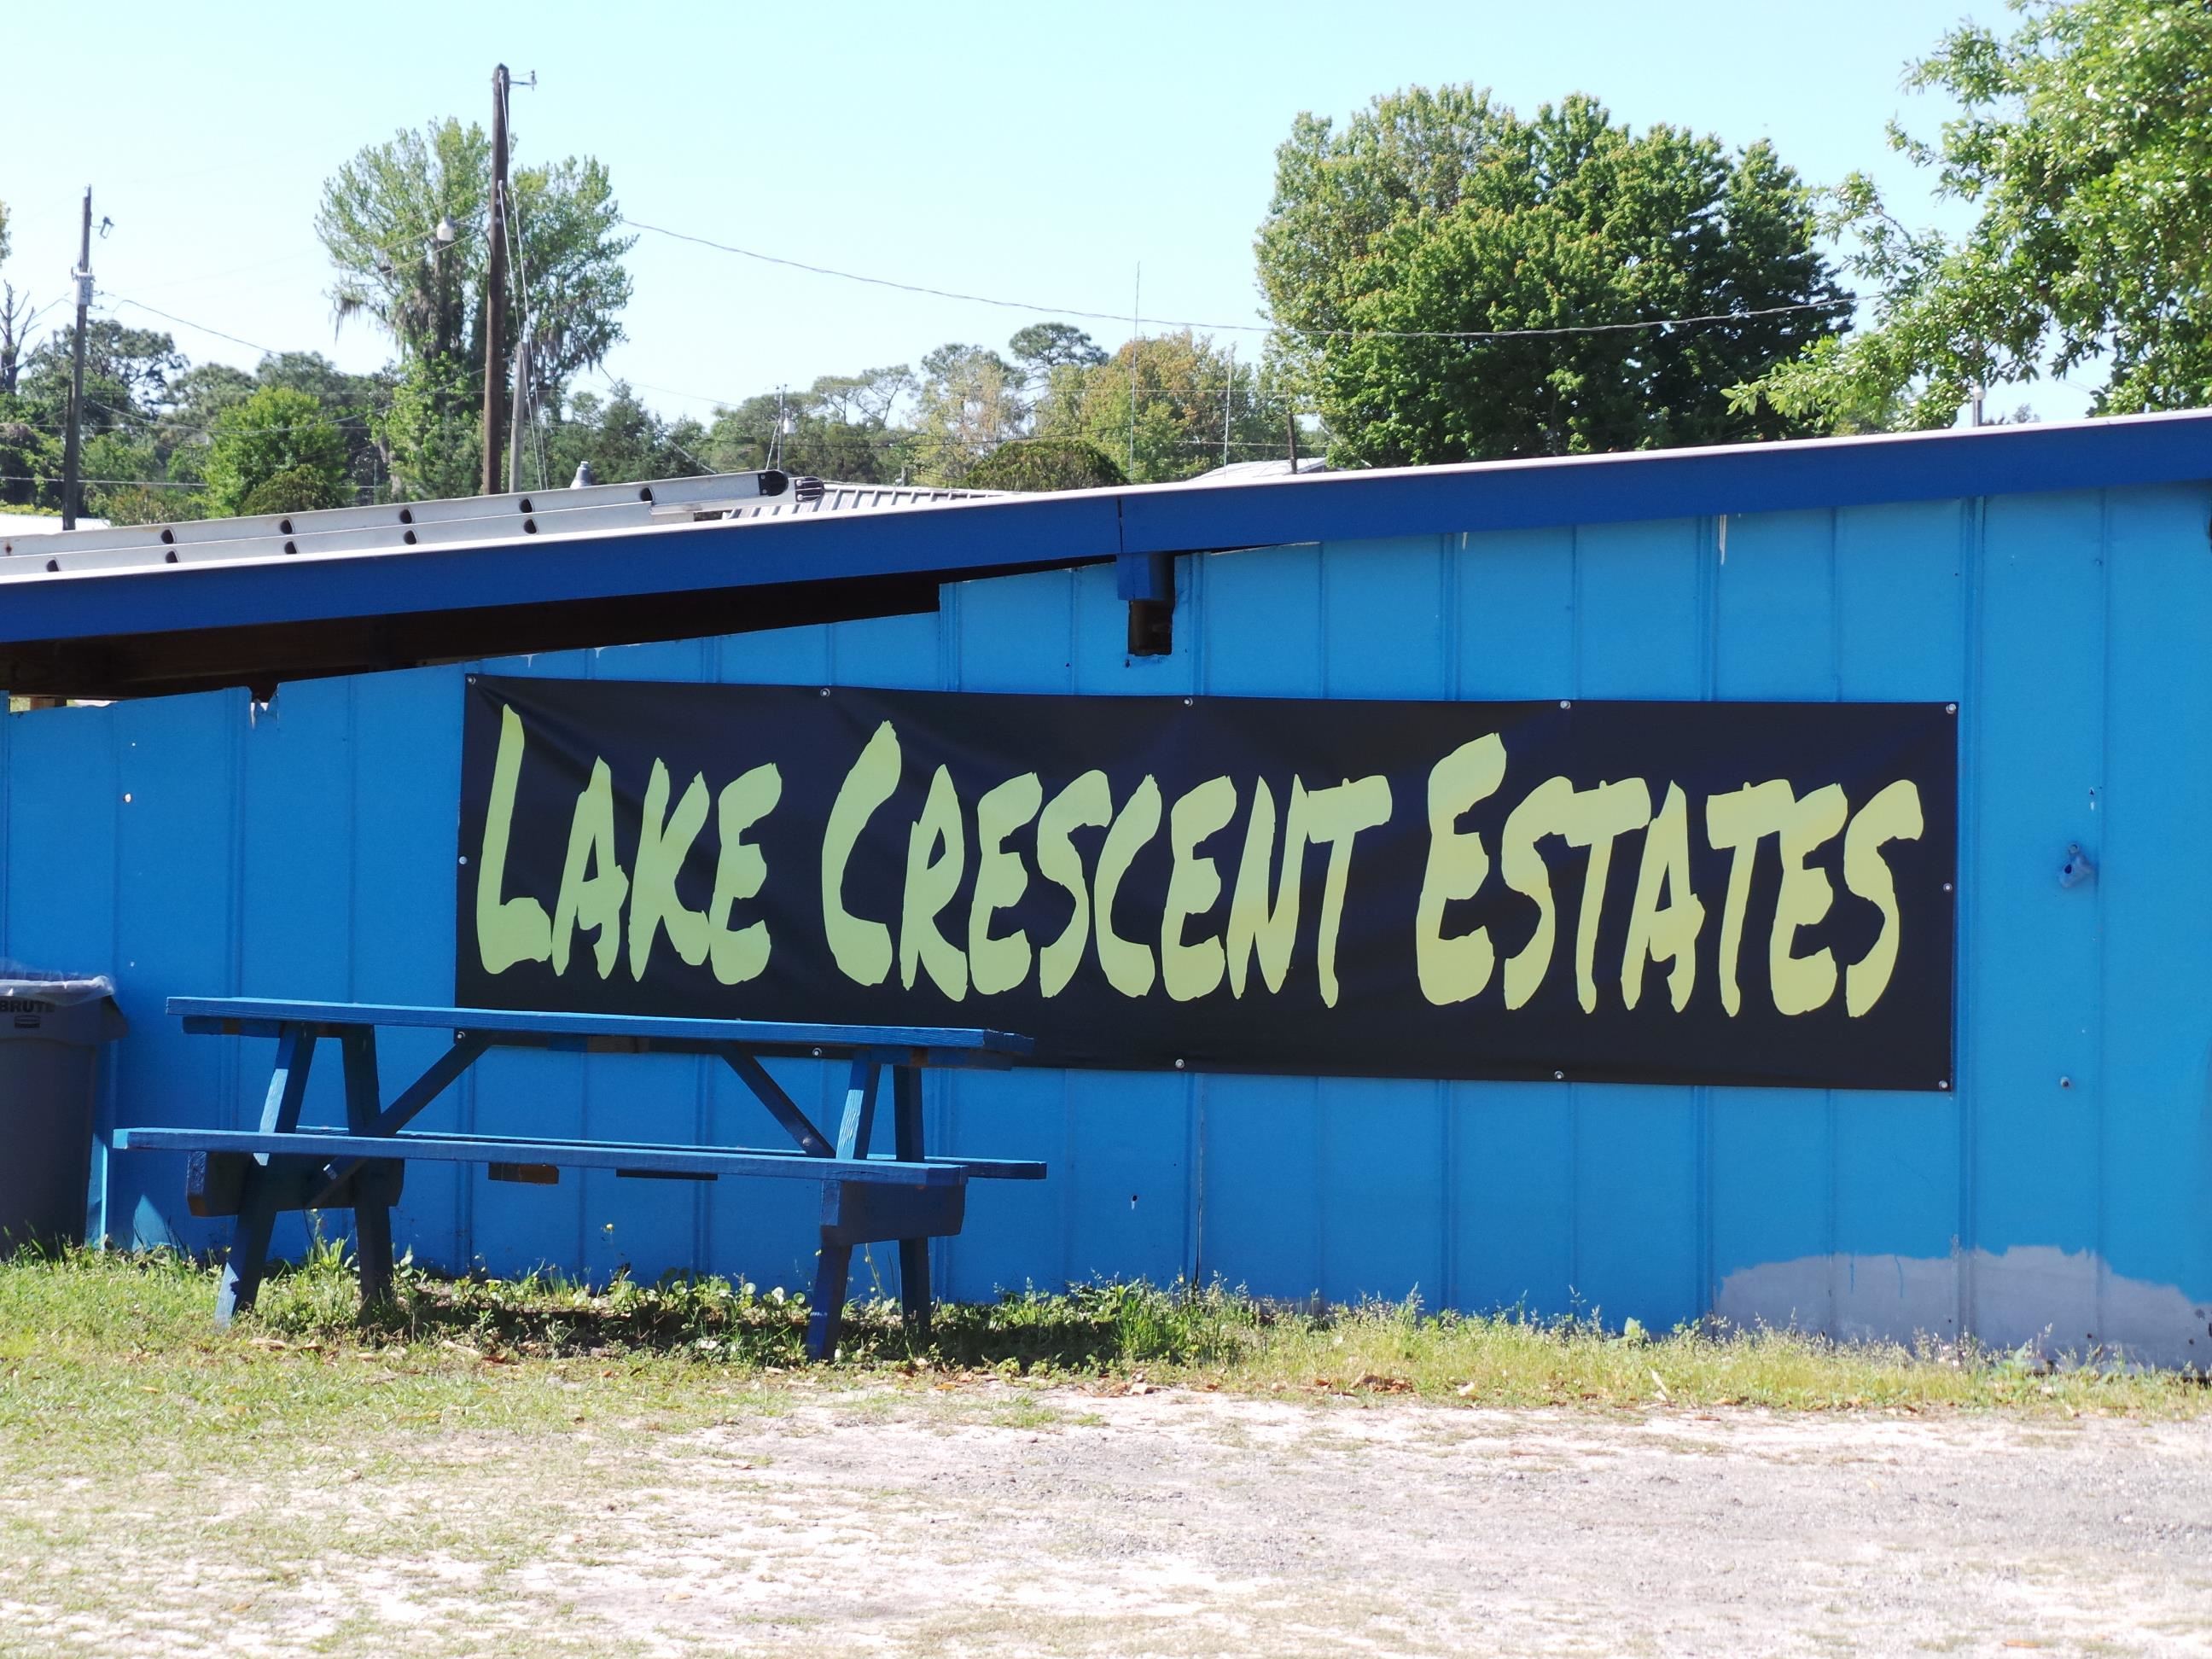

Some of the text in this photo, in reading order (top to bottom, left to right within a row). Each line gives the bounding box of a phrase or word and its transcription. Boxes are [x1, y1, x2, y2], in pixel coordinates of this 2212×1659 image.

[477, 705, 1924, 1017] LAKE CRESCENT ESTATES
